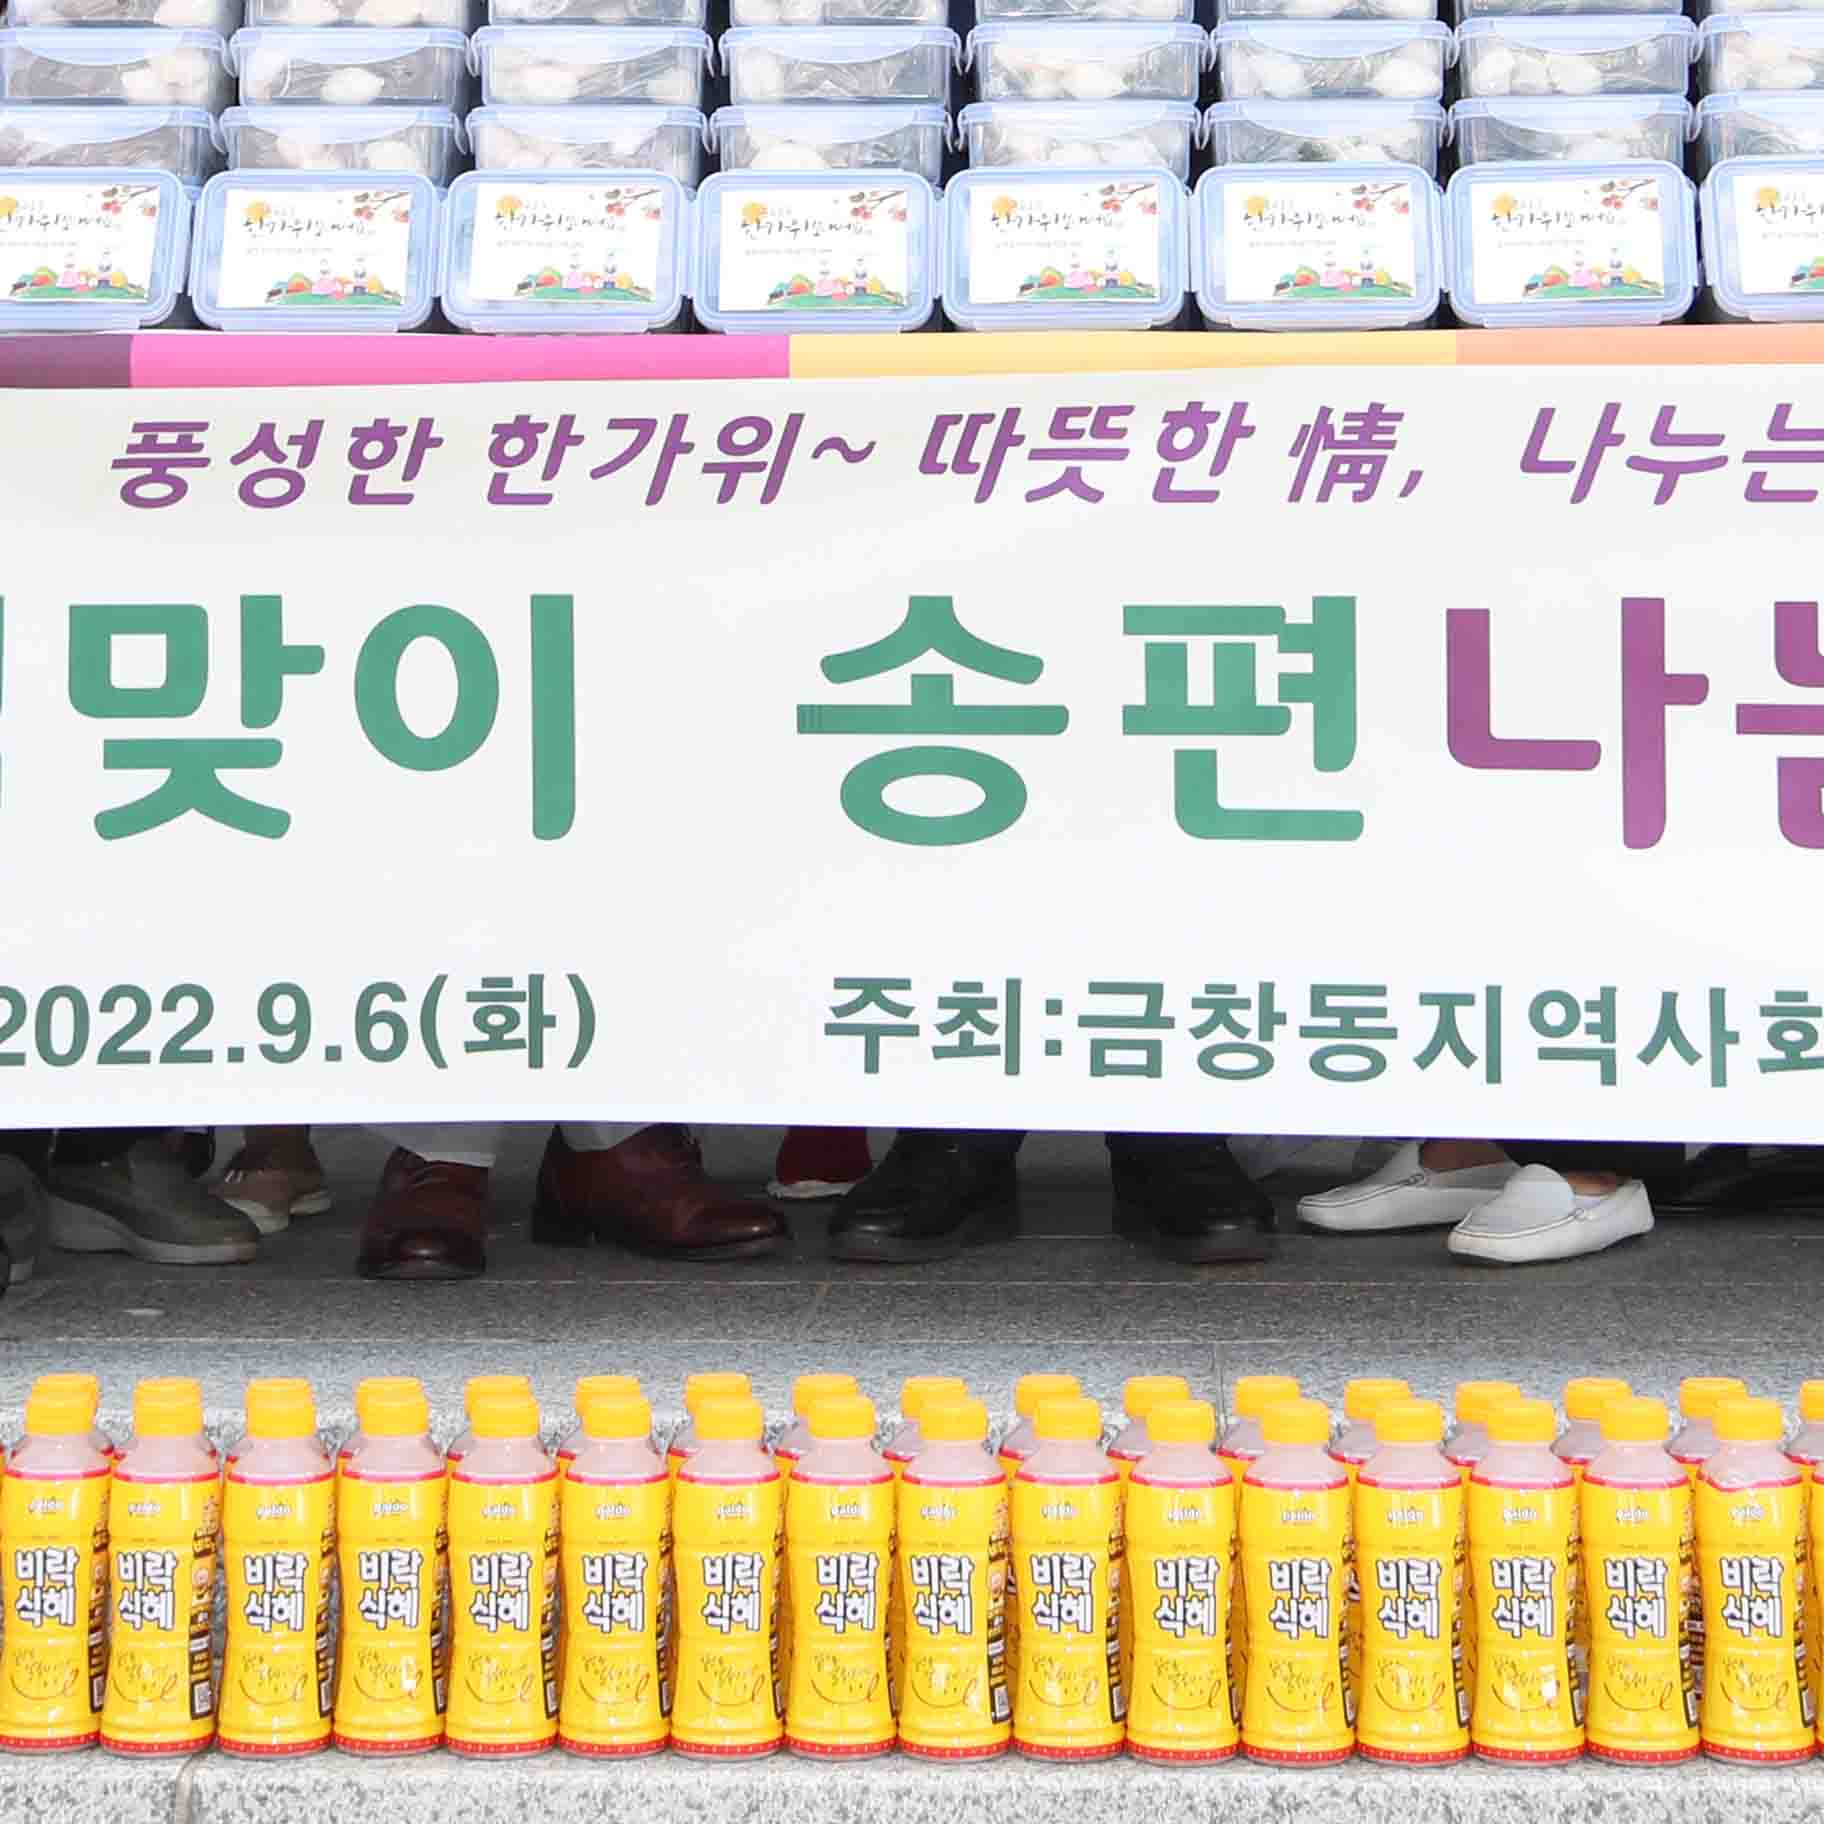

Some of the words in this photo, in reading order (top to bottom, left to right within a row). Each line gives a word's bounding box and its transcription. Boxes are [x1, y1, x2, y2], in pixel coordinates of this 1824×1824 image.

[111, 417, 442, 509] 풍성한
[487, 414, 874, 506] 한가위~
[918, 401, 1256, 504] 따뜻한
[1288, 402, 1424, 504] 情,
[15, 1546, 78, 1587] 비락
[118, 1548, 177, 1590] 비락
[245, 1550, 307, 1592] 비락
[359, 1547, 422, 1589] 비락
[471, 1550, 531, 1592] 비락
[583, 1550, 647, 1593] 비락
[703, 1551, 763, 1593] 비락
[816, 1550, 878, 1593] 비락
[911, 1554, 974, 1596] 비락
[1031, 1550, 1095, 1593] 비락
[1156, 1555, 1219, 1597] 비락
[1270, 1557, 1331, 1599] 비락
[1377, 1557, 1441, 1599] 비락
[1492, 1556, 1554, 1598] 비락
[1606, 1555, 1668, 1598] 비락
[1721, 1555, 1783, 1598] 비락
[15, 1584, 76, 1626] 식혜
[118, 1587, 175, 1630] 식혜
[245, 1589, 305, 1632] 식혜
[359, 1586, 420, 1629] 식혜
[471, 1589, 529, 1632] 식혜
[583, 1589, 645, 1633] 식혜
[703, 1590, 761, 1633] 식혜
[816, 1589, 876, 1633] 식혜
[911, 1593, 972, 1635] 식혜
[1031, 1589, 1093, 1633] 식혜
[1156, 1594, 1217, 1637] 식혜
[1270, 1596, 1329, 1639] 식혜
[1377, 1596, 1439, 1638] 식혜
[1492, 1595, 1552, 1638] 식혜
[1606, 1594, 1666, 1638] 식혜
[1721, 1594, 1781, 1638] 식혜
